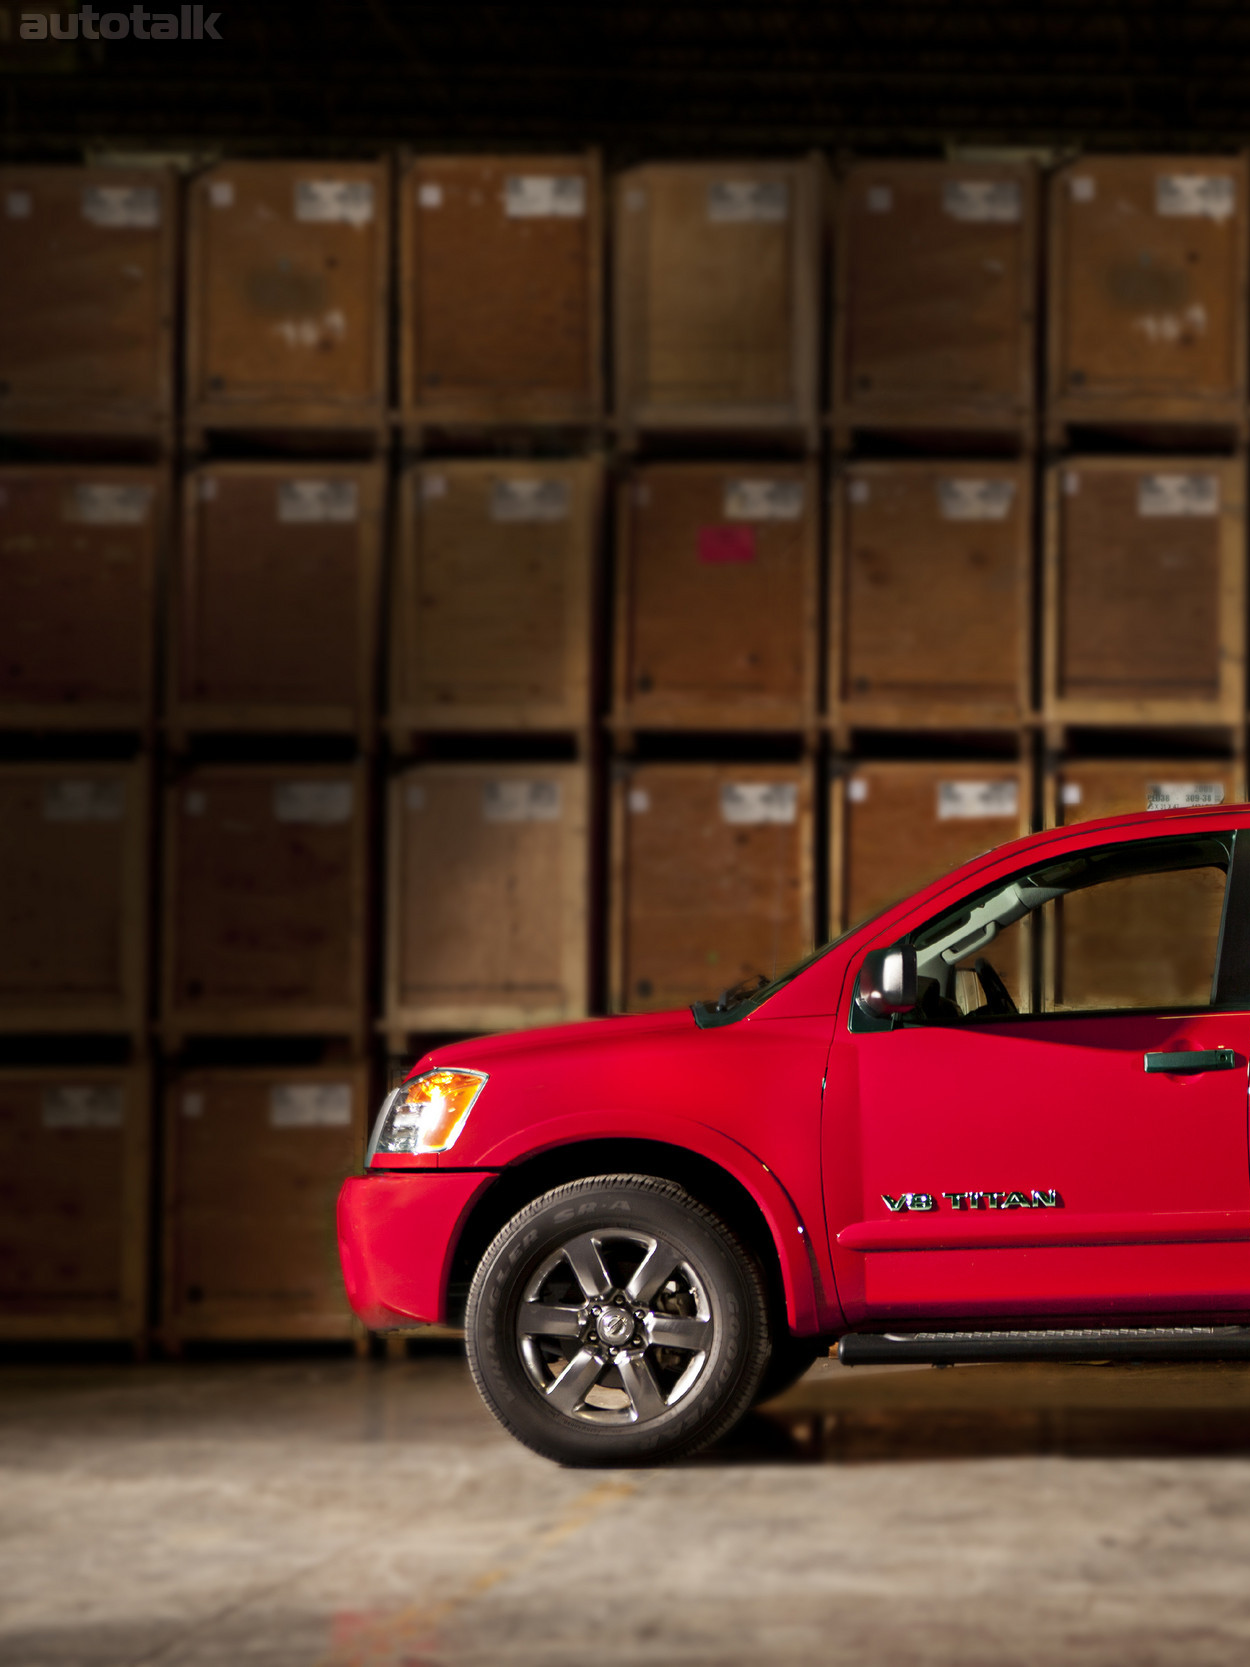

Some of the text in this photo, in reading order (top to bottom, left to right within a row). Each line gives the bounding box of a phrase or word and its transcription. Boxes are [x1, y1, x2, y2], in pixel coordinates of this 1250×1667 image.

[1185, 794, 1212, 802] 309-38
[881, 1189, 1056, 1212] V8 TITAN
